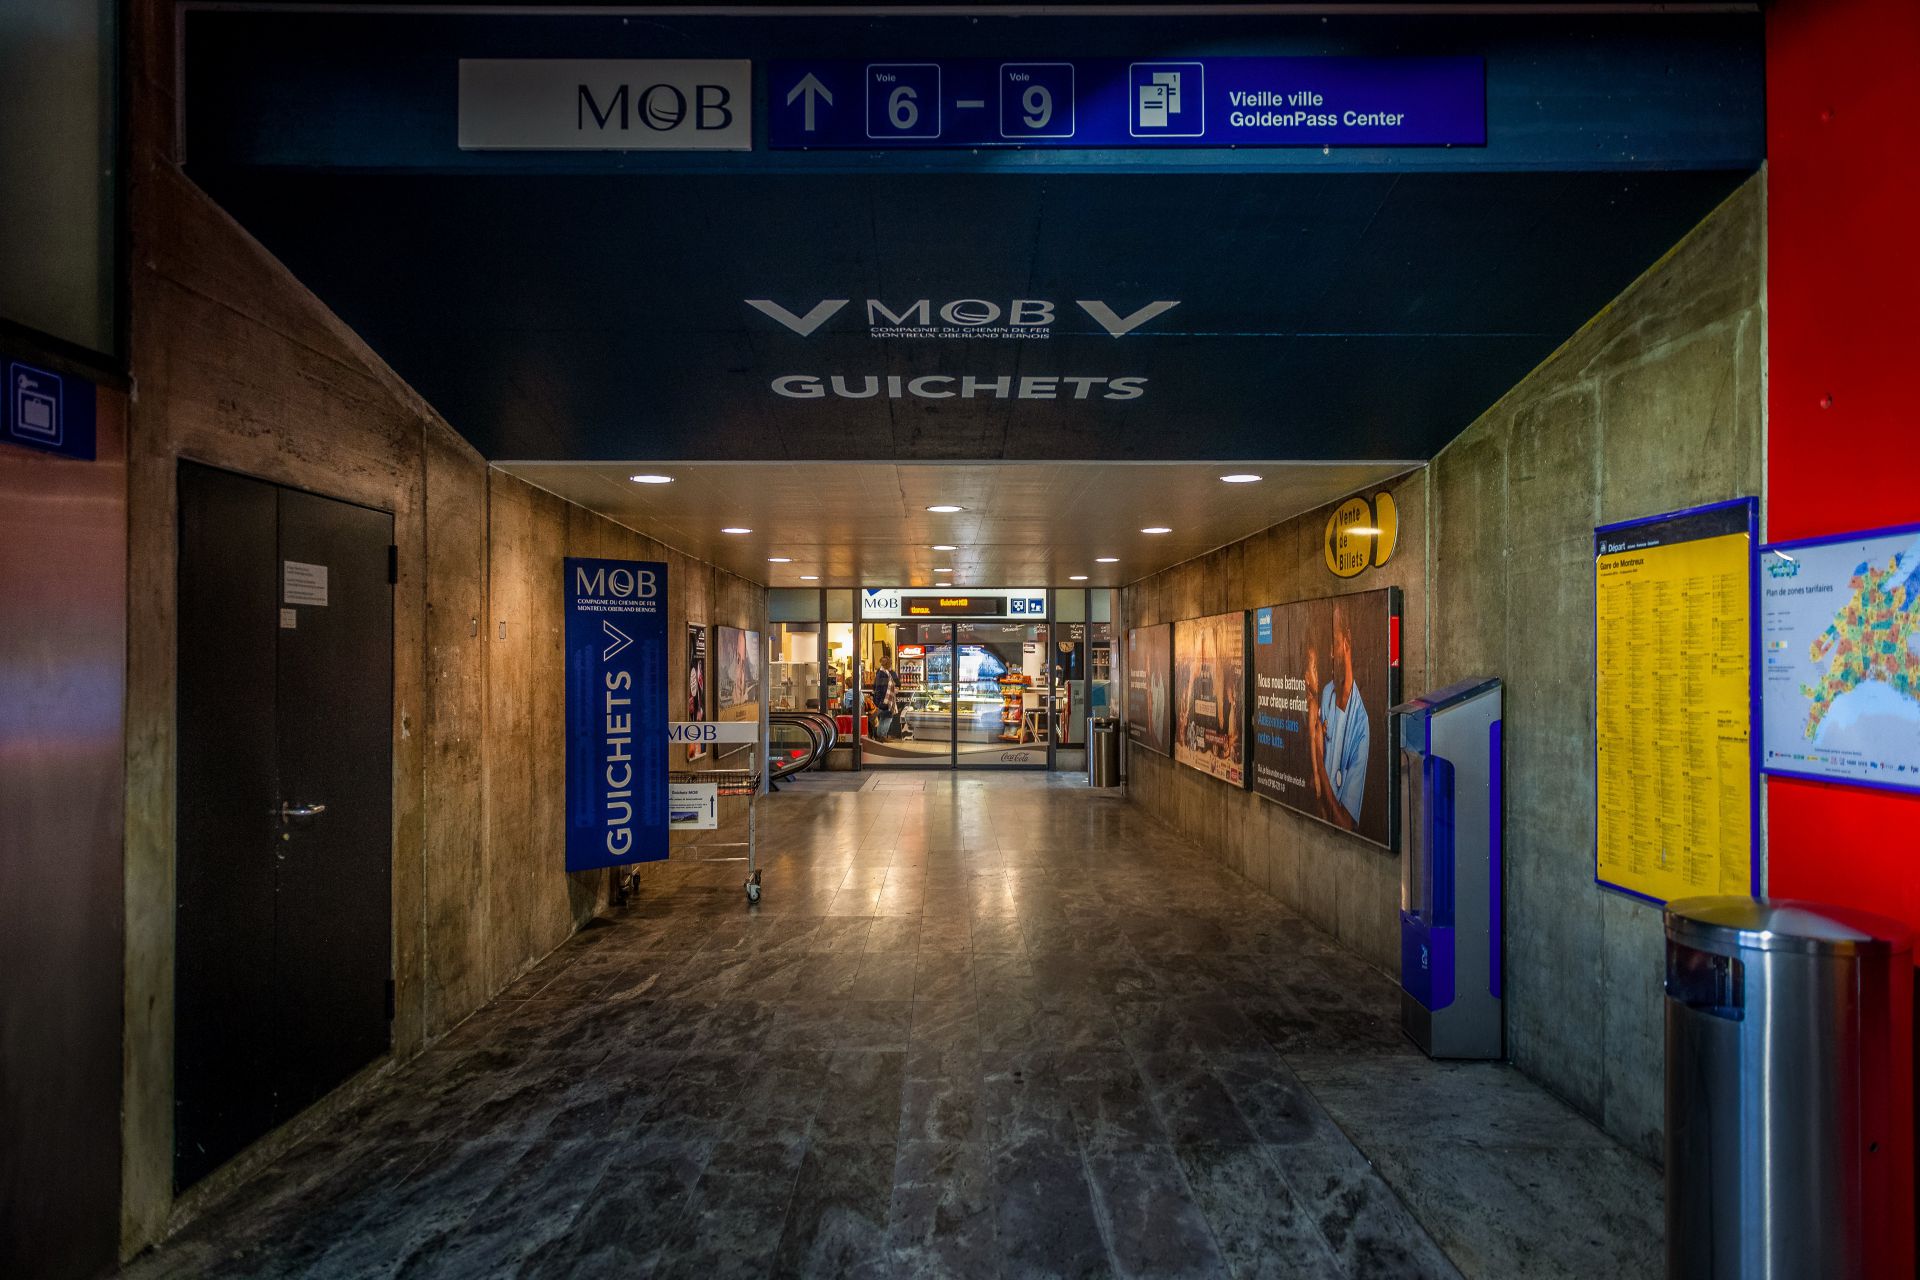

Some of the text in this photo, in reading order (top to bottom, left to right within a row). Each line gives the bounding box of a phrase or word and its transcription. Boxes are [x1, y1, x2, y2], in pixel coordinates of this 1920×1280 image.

[876, 73, 896, 82] Voie
[1009, 73, 1030, 82] Voie
[577, 83, 733, 131] MOB
[888, 85, 919, 130] 6
[1022, 84, 1053, 129] 9
[1229, 91, 1323, 107] Vieille ville
[1229, 111, 1405, 127] GoldenPass Center
[866, 299, 1055, 326] MOB
[771, 374, 1149, 400] GUICHETS
[1340, 507, 1361, 526] Vente
[1340, 532, 1348, 549] de
[1608, 541, 1626, 553] Départ
[1340, 549, 1363, 571] Billets
[1600, 558, 1645, 571] Gare de Montreux
[577, 567, 657, 598] MOB
[1766, 584, 1833, 597] Plan de zones tarifaires
[864, 598, 898, 609] MOB
[1258, 673, 1306, 692] Nous nous battons
[1257, 693, 1308, 712] pour chaque enfant.
[668, 724, 717, 741] MOB
[605, 671, 633, 856] GUICHETS
